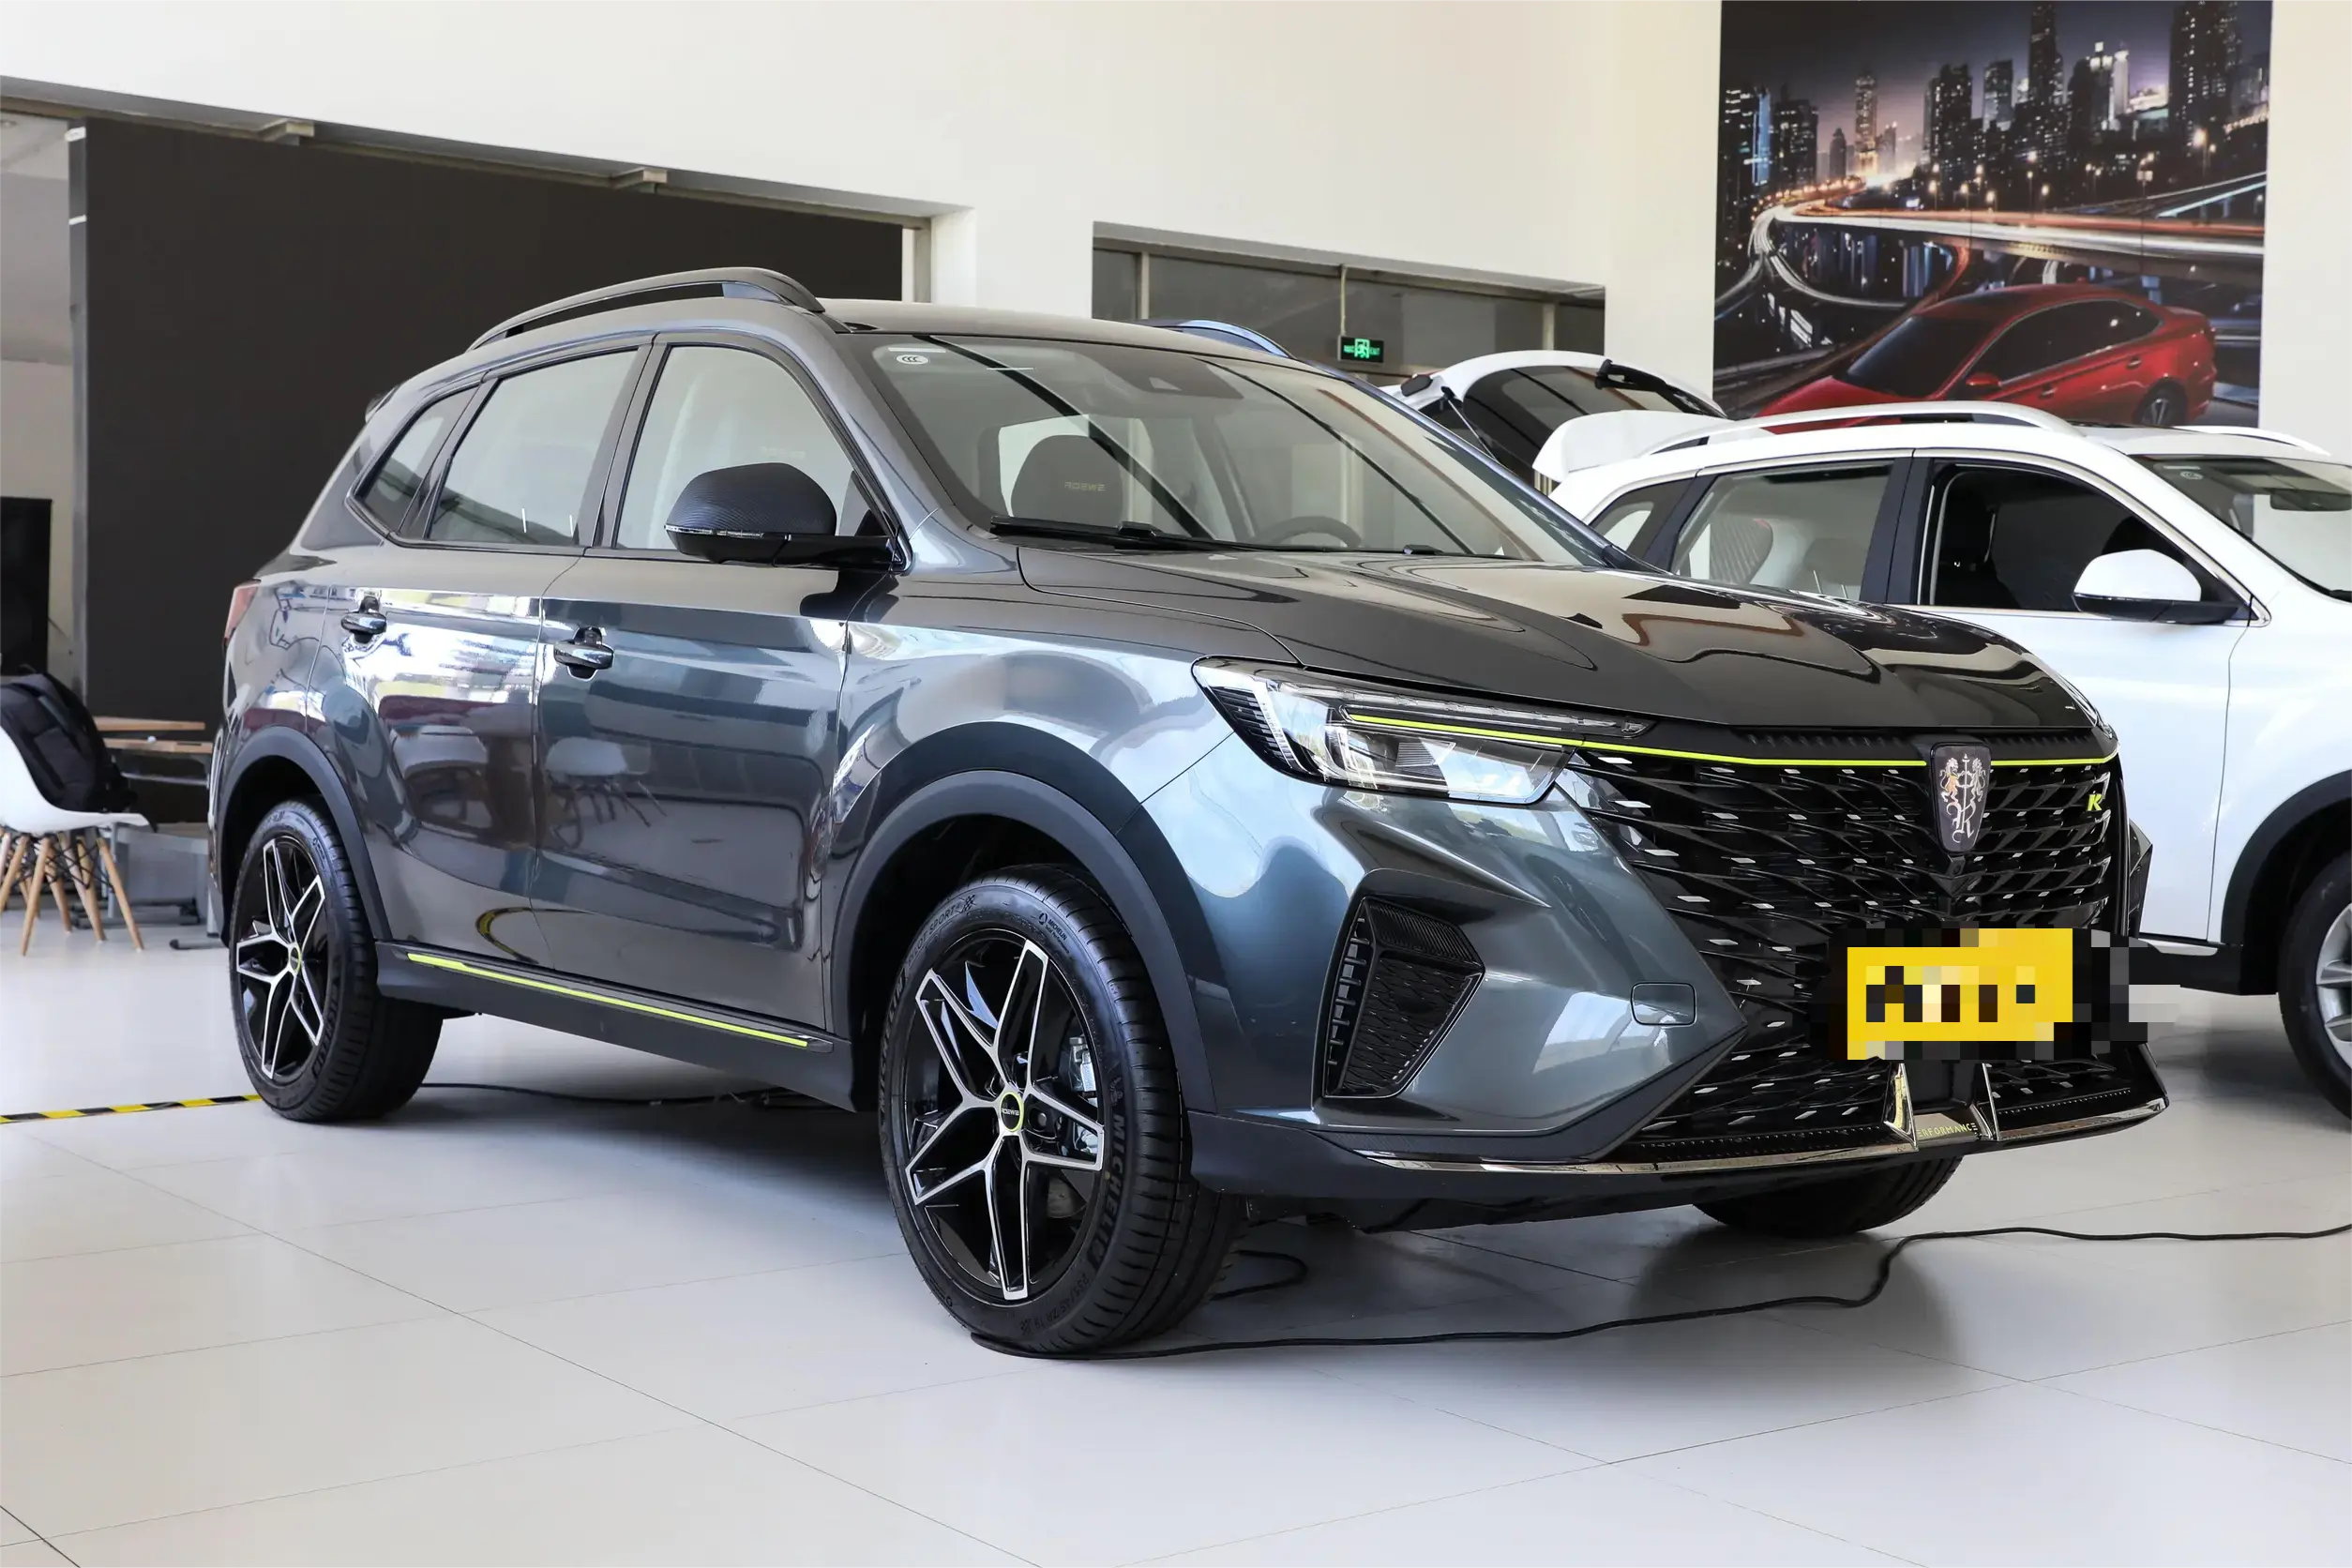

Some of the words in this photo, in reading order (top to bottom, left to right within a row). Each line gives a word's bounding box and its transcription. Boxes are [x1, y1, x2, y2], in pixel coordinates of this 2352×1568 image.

[928, 904, 956, 935] SPORT
[1048, 919, 1067, 941] MICHELIN
[1916, 1123, 1978, 1138] ERFORMANCE
[1090, 1113, 1126, 1268] MICHELIN
